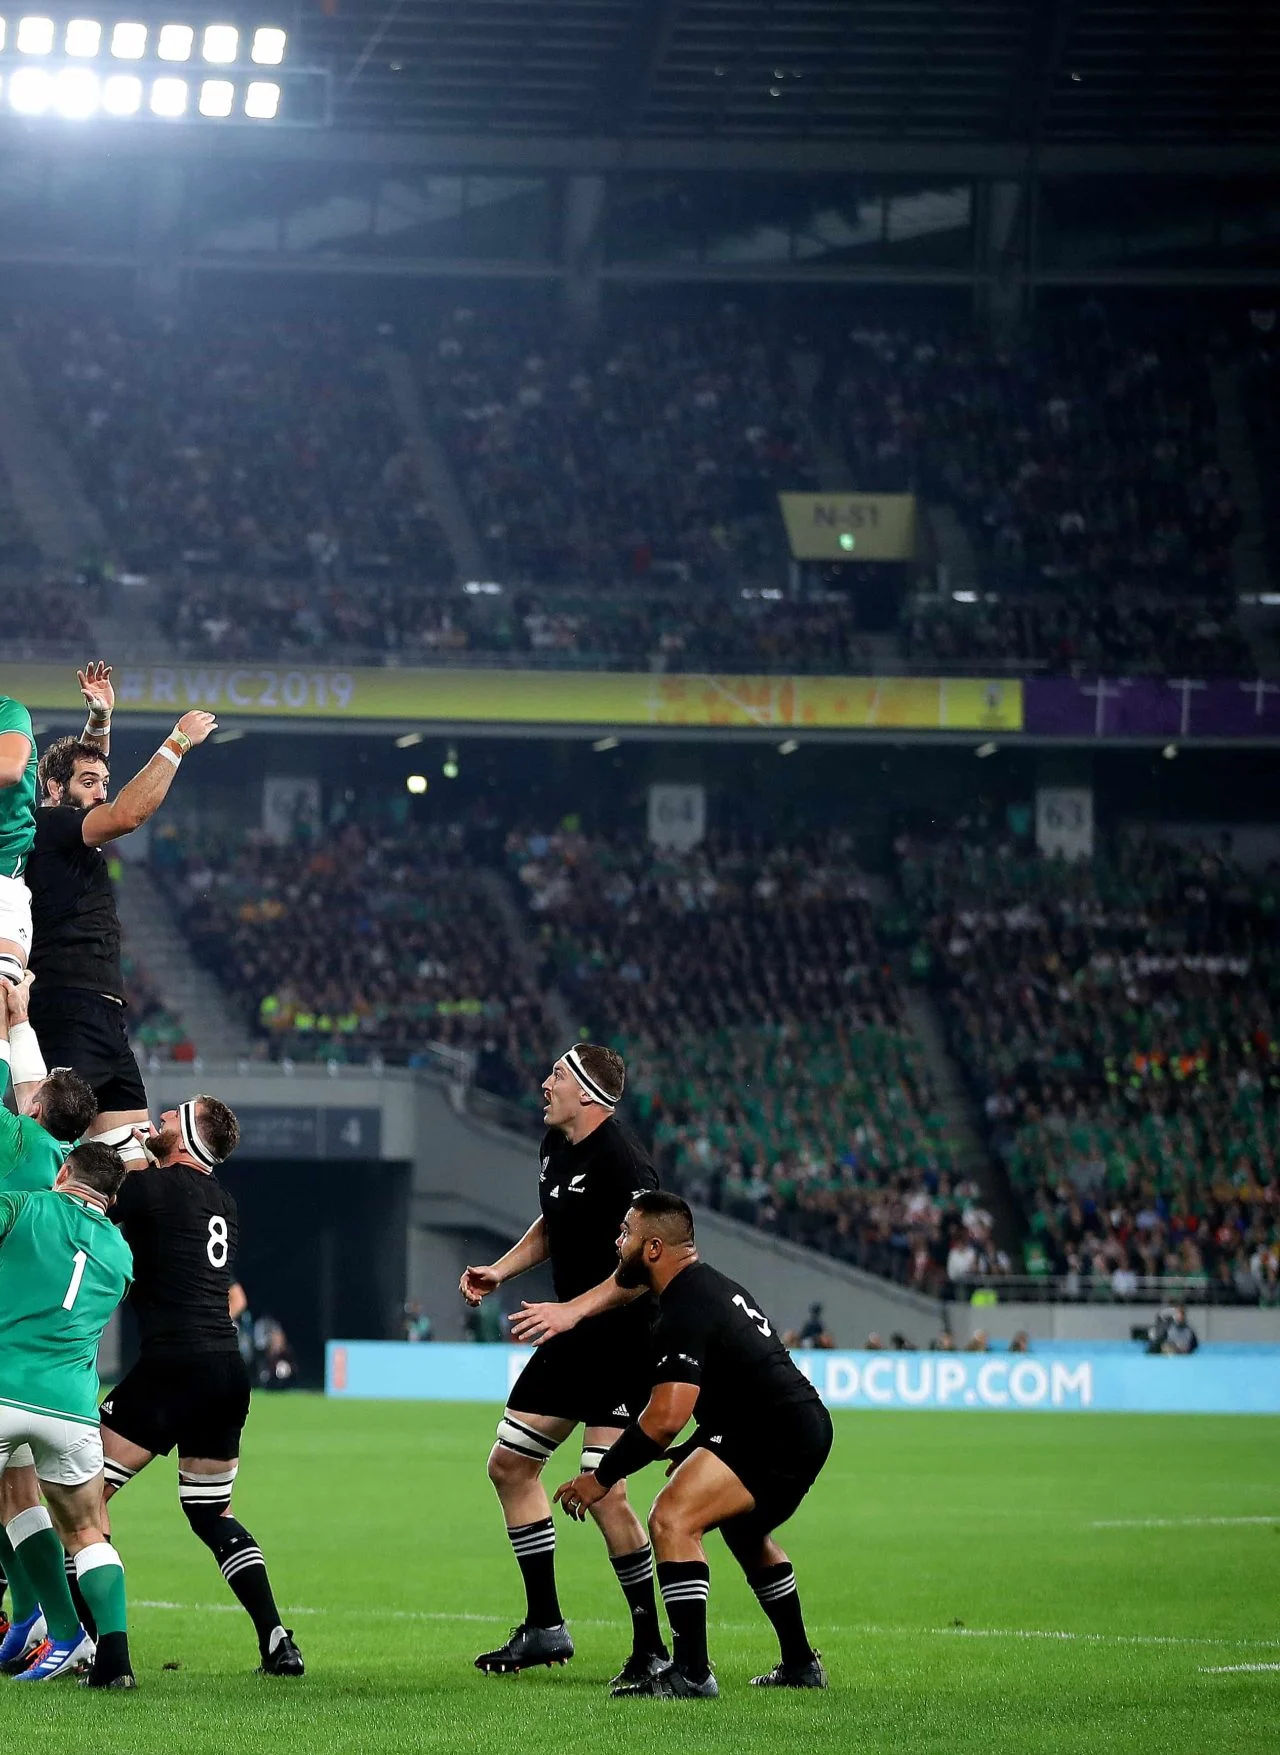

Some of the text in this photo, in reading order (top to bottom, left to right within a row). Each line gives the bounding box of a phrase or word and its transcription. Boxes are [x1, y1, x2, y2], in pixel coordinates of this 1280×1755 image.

[120, 668, 355, 710] #RWC2019
[206, 1216, 228, 1267] 8
[63, 1250, 87, 1311] 1
[731, 1295, 772, 1338] 3
